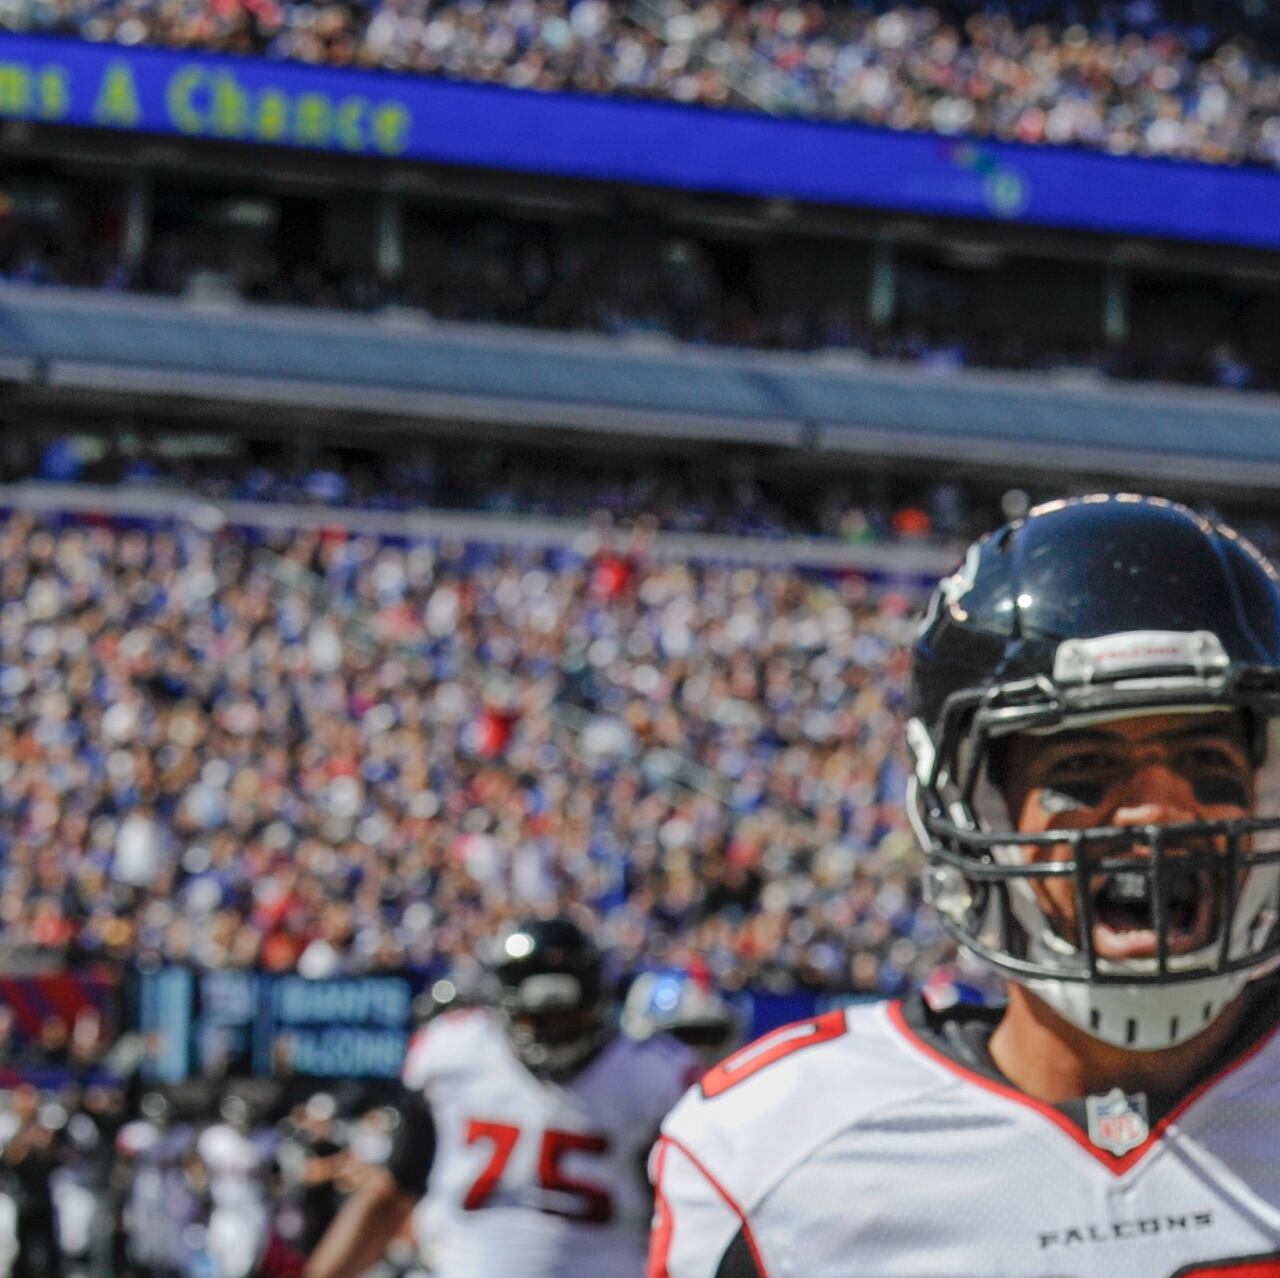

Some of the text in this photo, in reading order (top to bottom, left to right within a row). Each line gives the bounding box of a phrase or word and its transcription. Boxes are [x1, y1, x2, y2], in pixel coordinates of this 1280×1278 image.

[95, 57, 139, 128] A
[165, 63, 409, 154] Chance
[464, 1118, 613, 1225] 75
[1038, 1211, 1212, 1248] FALCONS
